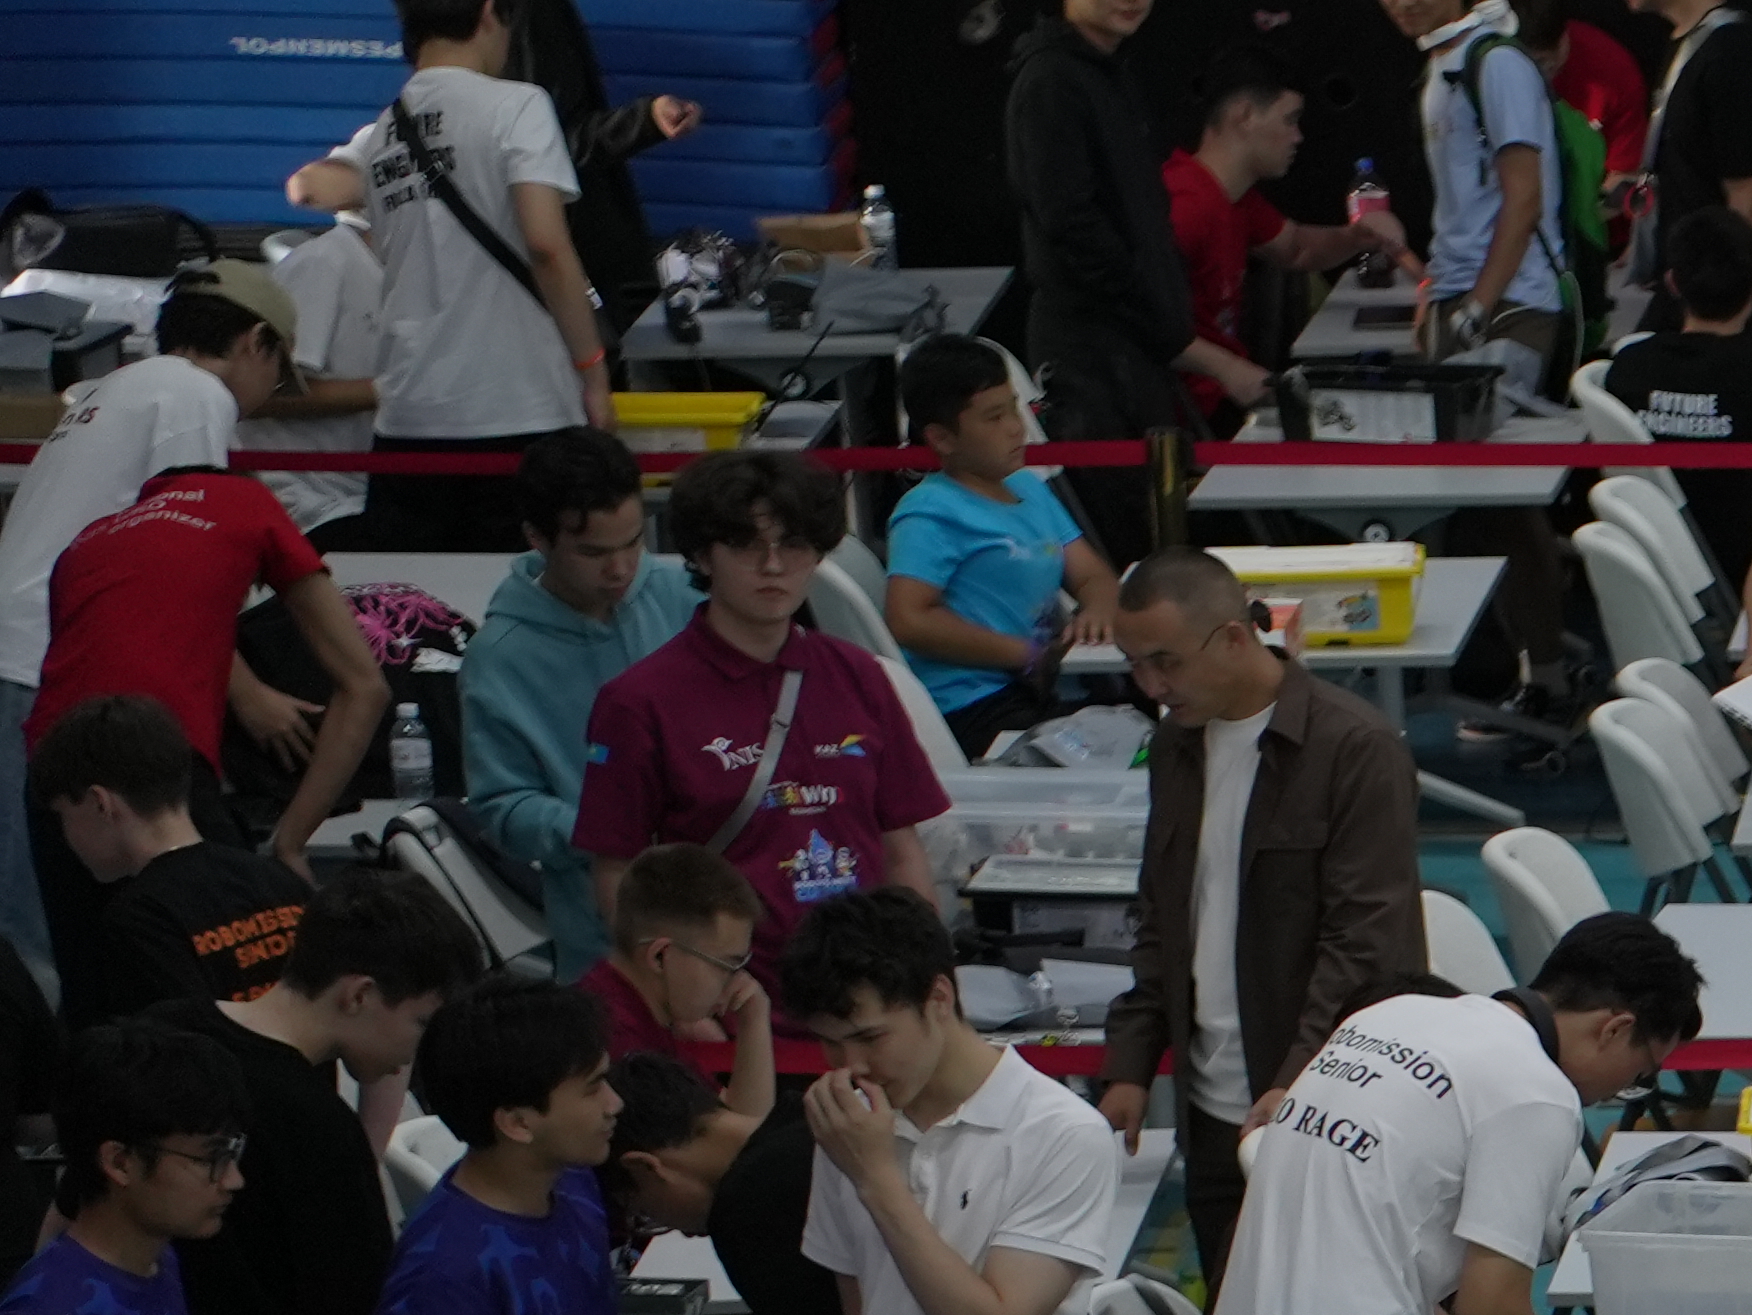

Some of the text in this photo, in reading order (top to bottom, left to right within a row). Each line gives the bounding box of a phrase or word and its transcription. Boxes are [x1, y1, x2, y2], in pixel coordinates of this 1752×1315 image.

[1309, 1051, 1384, 1090] Senior
[1330, 1025, 1454, 1100] obomission
[1294, 1098, 1383, 1165] RAGE
